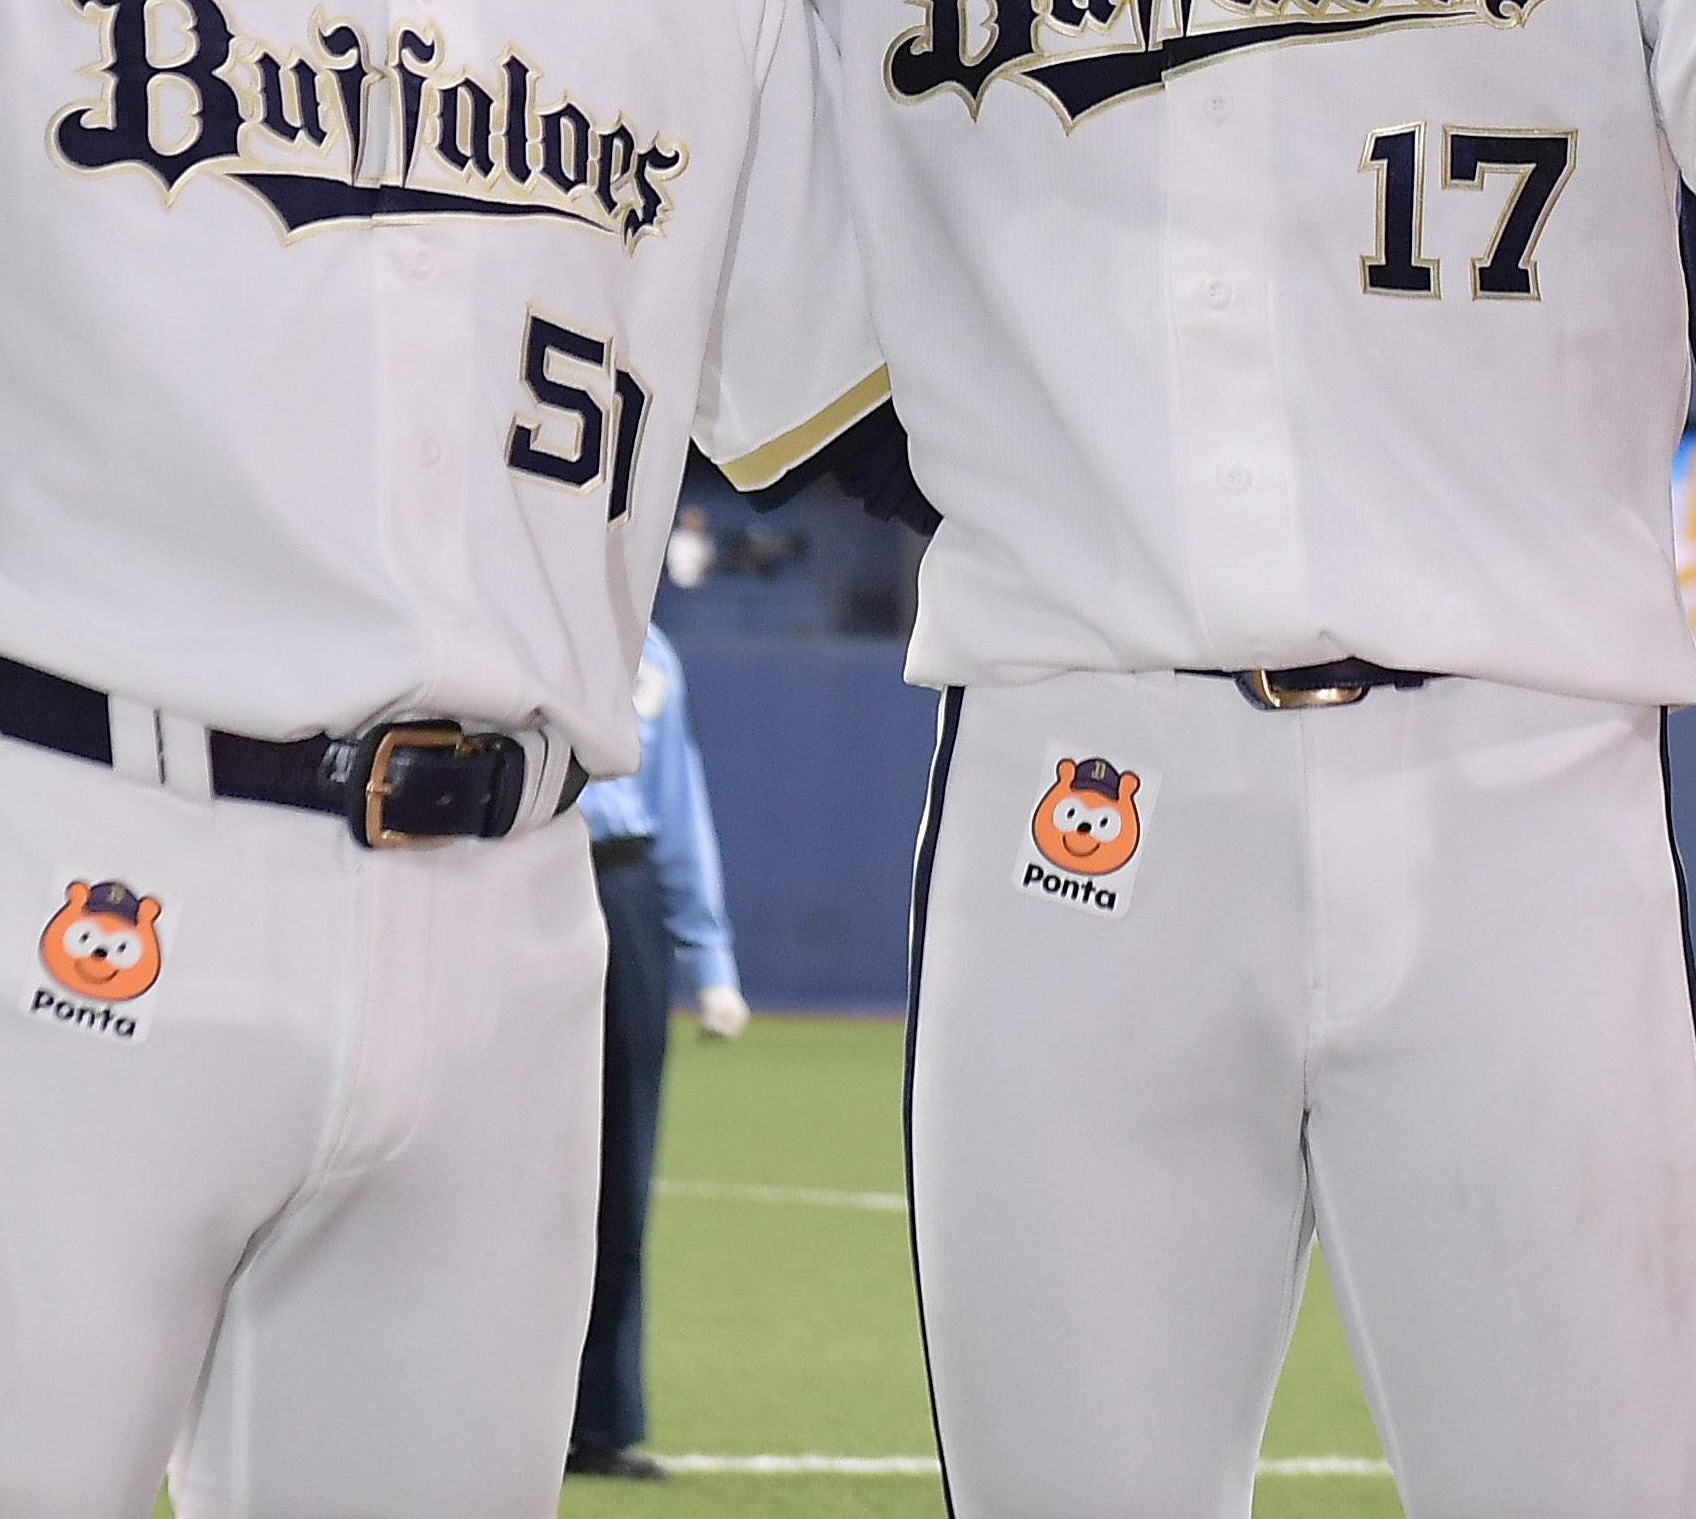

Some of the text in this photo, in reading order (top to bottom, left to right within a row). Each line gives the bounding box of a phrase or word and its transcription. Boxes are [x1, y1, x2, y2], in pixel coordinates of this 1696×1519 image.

[1358, 120, 1579, 302] 17
[502, 303, 653, 530] 51
[1022, 863, 1117, 911] Ponta
[30, 986, 137, 1038] Ponta
